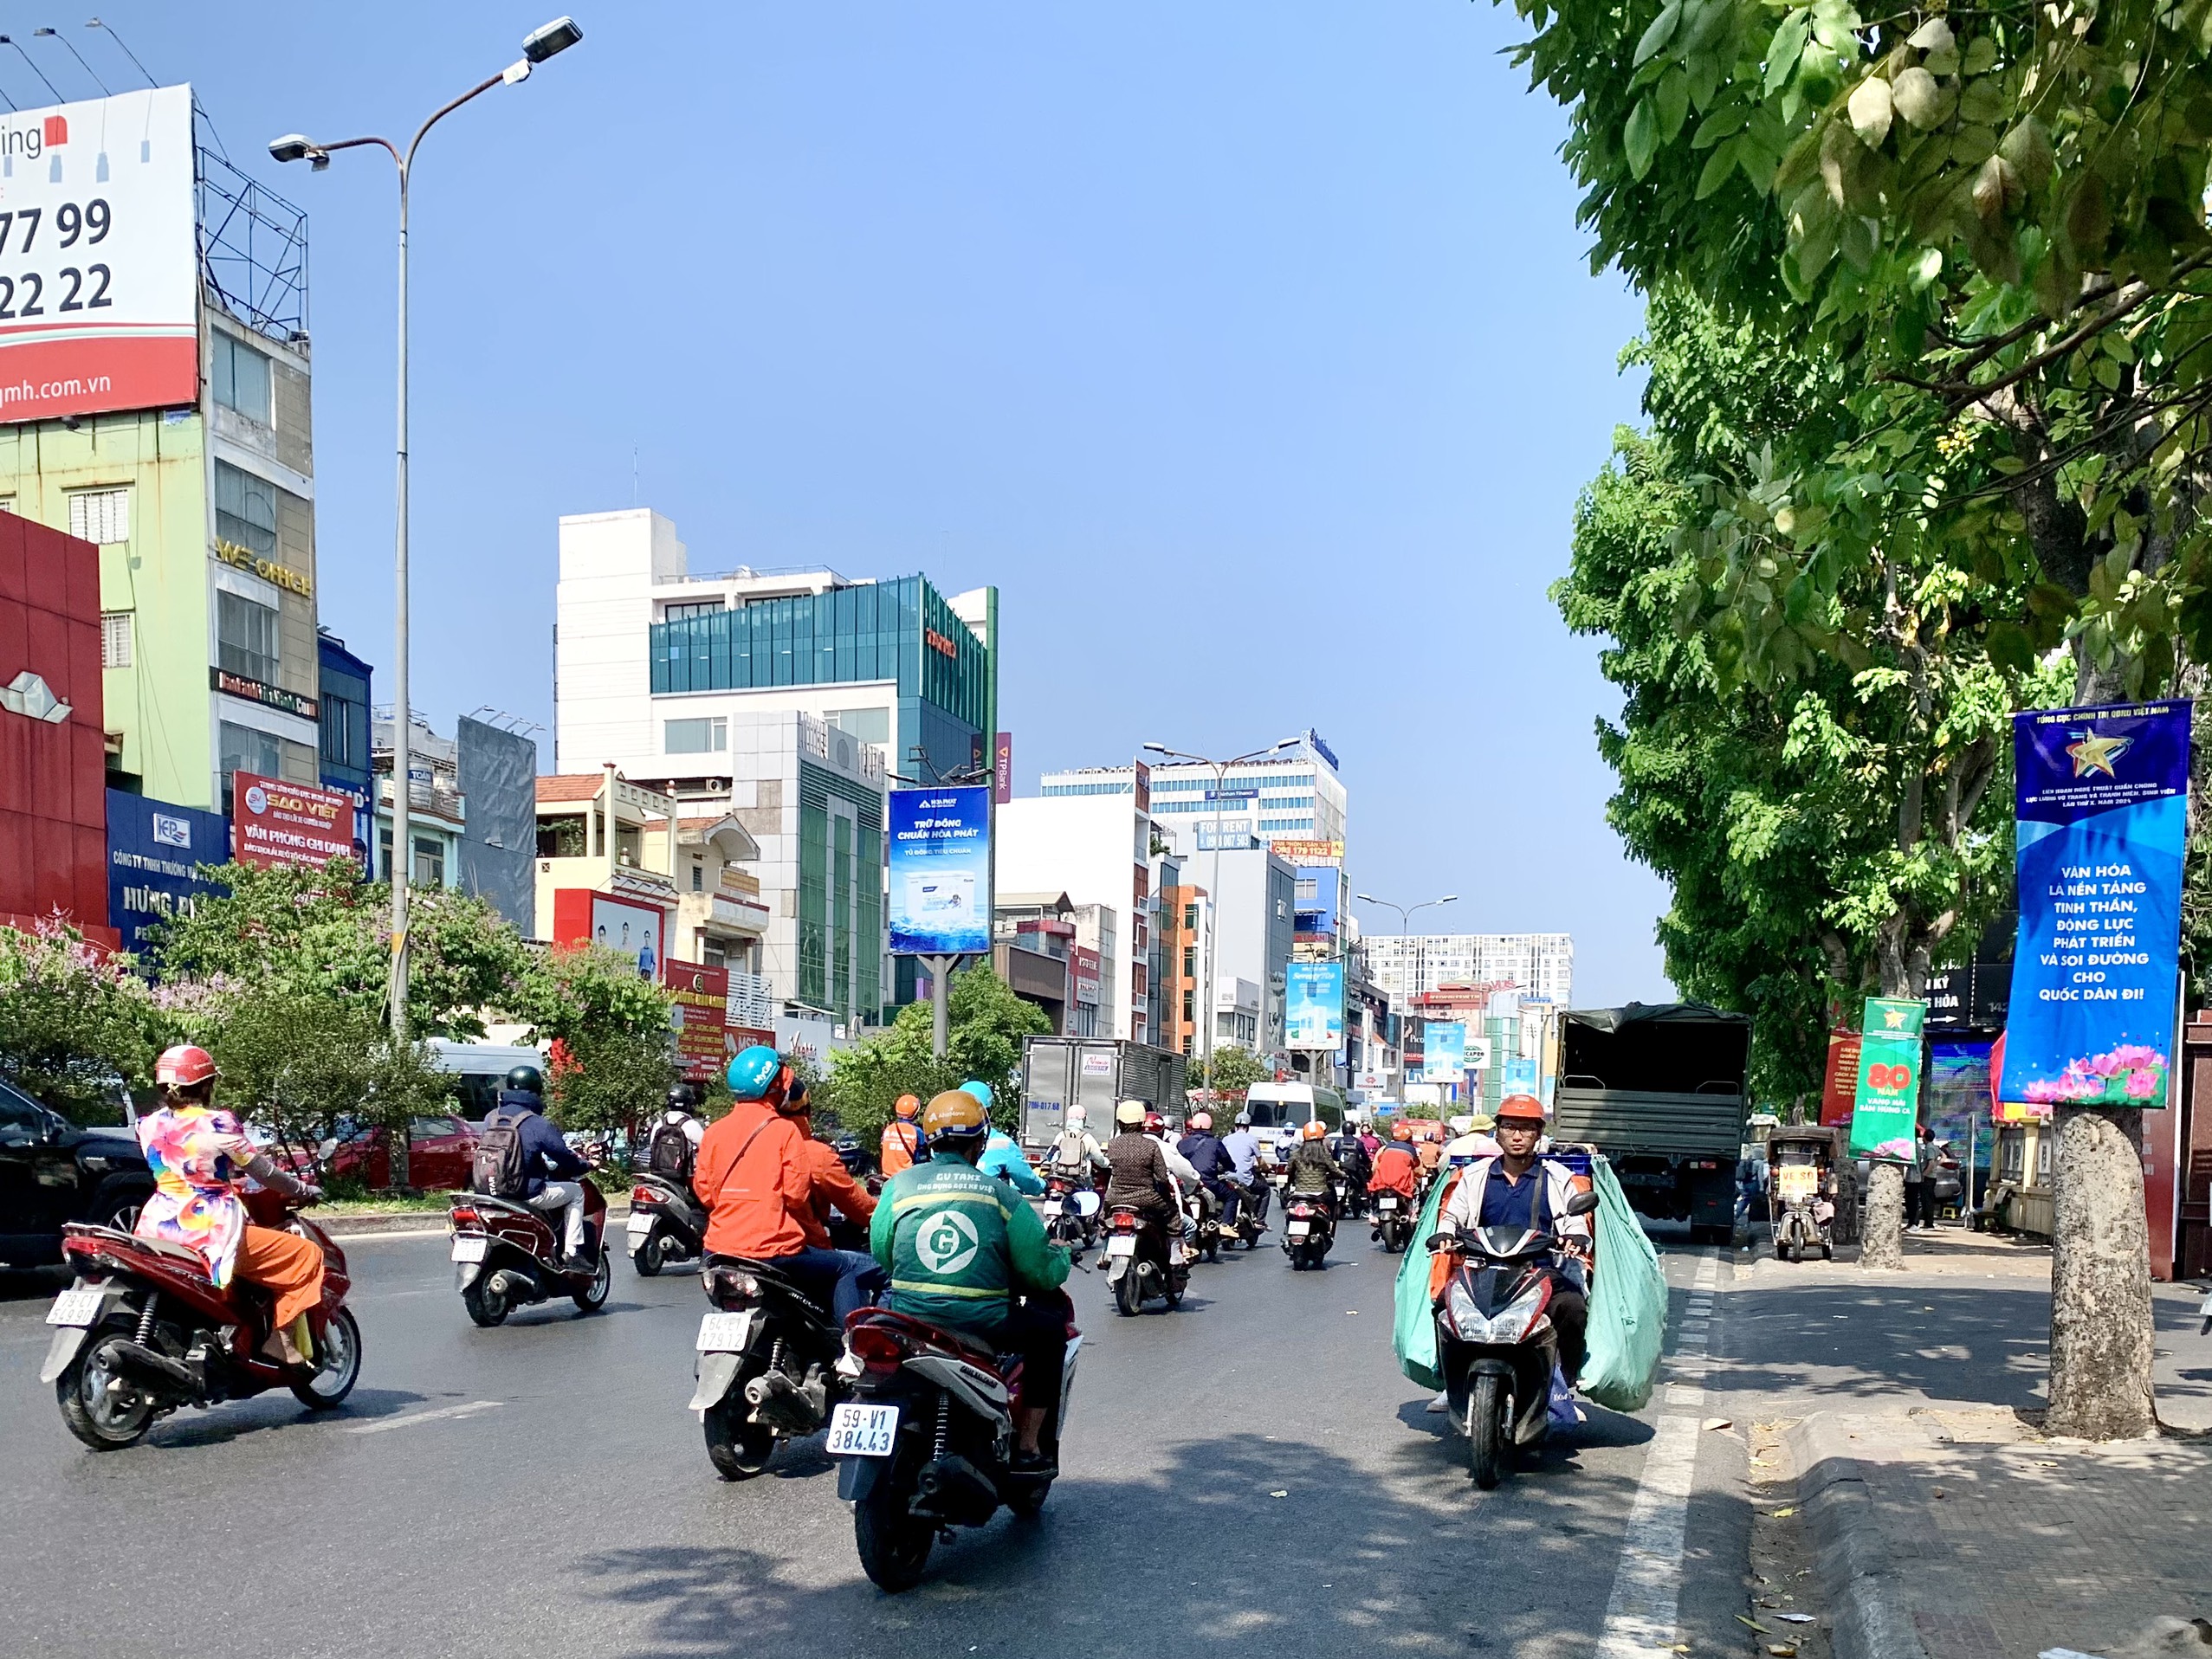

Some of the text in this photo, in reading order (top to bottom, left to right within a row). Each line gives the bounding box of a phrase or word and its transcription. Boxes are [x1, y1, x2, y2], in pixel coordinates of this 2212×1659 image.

[56, 198, 111, 249] 99
[59, 263, 112, 312] 22
[0, 376, 111, 409] mh.com.vn
[256, 558, 311, 597] OFFICE
[2056, 713, 2072, 724] CỤC
[2073, 712, 2095, 721] CHÍNH
[2098, 711, 2110, 720] TRỊ
[2133, 707, 2149, 717] VIỆT
[2151, 706, 2170, 714] NAM
[999, 758, 1008, 790] TPBank
[267, 794, 302, 811] SAO
[306, 802, 339, 820] VIỆT
[914, 817, 961, 829] TRỮ ĐÔNG
[1222, 821, 1248, 833] RENT
[244, 823, 351, 856] VĂN PHÒNG GHI DANH
[897, 829, 979, 840] CHUẨN HÒA PHÁT
[113, 849, 132, 868] CÔNG
[133, 855, 143, 868] TY
[143, 856, 160, 872] TNHH
[161, 860, 186, 877] THƯƠNG
[2061, 862, 2131, 878] VĂN HÓA
[2049, 880, 2146, 896] LÀ NỀN TẢNG
[123, 885, 171, 913] HƯNG
[2054, 897, 2138, 913] TINH THẦN,
[2056, 918, 2134, 933] ĐỘNG LỰC
[2054, 932, 2135, 949] PHÁT TRIỂN
[2041, 951, 2150, 967] VÀ SOI ĐƯỜNG
[1933, 975, 1950, 990] KÝ
[2073, 972, 2106, 984] CHO
[1934, 993, 1959, 1008] HÒA
[2039, 987, 2144, 1002] QUỐC DÂN ĐI!
[1866, 1063, 1911, 1090] 80
[954, 1172, 981, 1182] TAXI
[833, 1430, 889, 1451] 384.43
